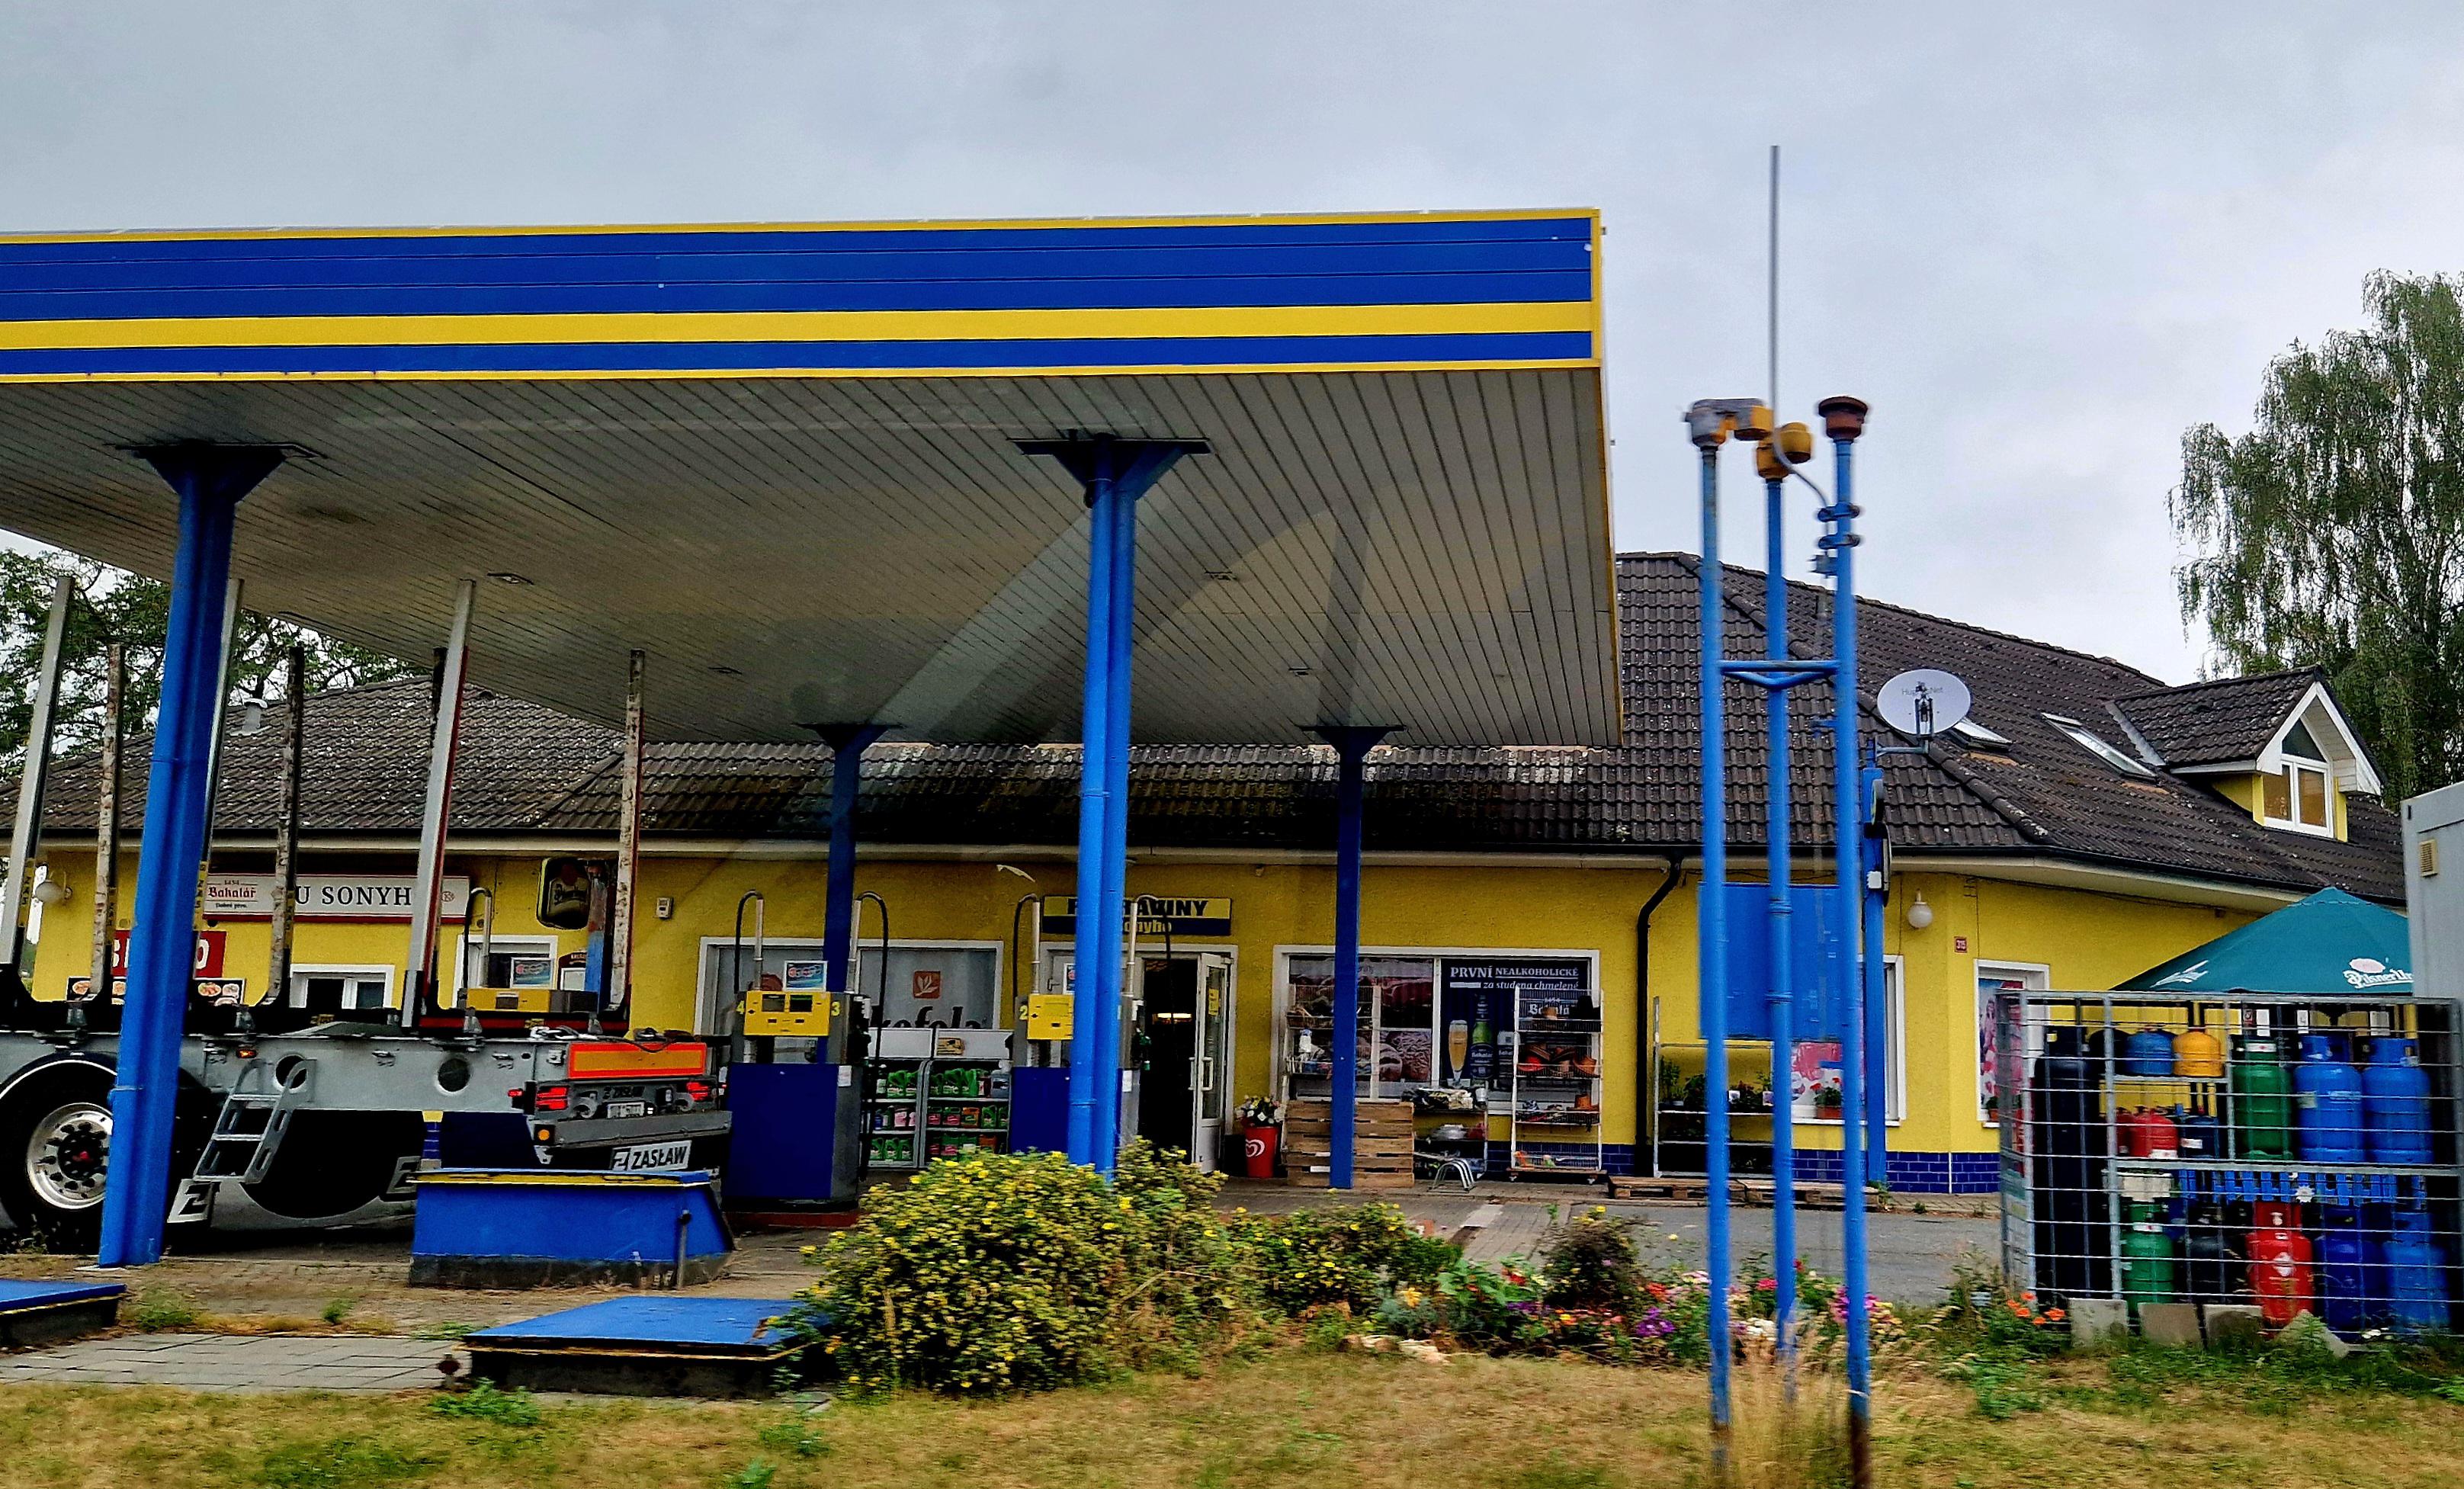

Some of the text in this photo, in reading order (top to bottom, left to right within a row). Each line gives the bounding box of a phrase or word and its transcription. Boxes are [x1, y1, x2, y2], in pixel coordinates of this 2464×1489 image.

[208, 886, 256, 898] Bakalář
[294, 886, 414, 906] U SONYH
[1067, 899, 1209, 916] RAVINY
[1123, 919, 1172, 933] onyho
[1450, 965, 1579, 978] PRVNÍ NEALKOHOLICKÉ
[736, 1000, 745, 1015] 4
[831, 1001, 841, 1016] 3
[1019, 1005, 1028, 1020] 2
[631, 1145, 687, 1170] ZASŁAW
